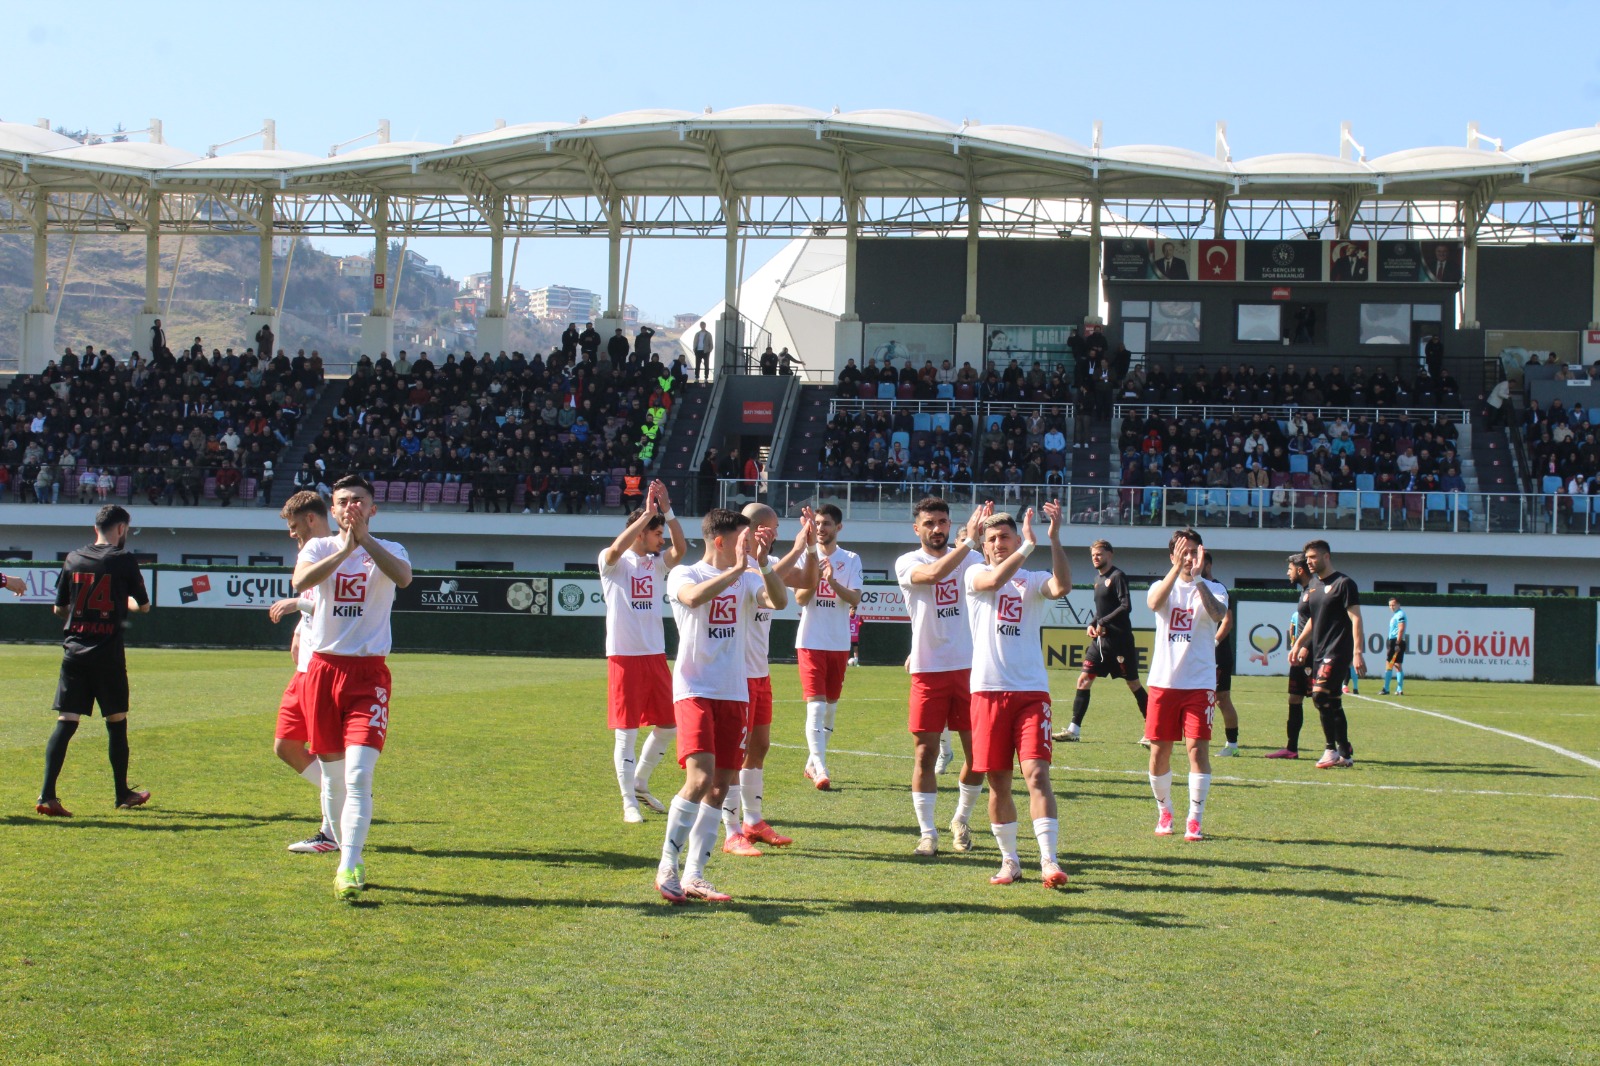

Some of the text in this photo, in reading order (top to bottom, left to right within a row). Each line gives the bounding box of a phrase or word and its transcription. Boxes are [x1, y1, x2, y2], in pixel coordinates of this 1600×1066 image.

[375, 275, 383, 285] B
[73, 572, 114, 617] 74
[421, 593, 479, 604] SAKARYA
[631, 601, 653, 610] Kilit
[816, 599, 836, 608] Kilit
[333, 605, 363, 617] Kilit
[937, 608, 960, 618] Kilit
[708, 627, 735, 639] Kilit
[850, 623, 856, 633] 3
[996, 624, 1021, 636] Kilit
[1168, 633, 1192, 643] Kilit
[1515, 659, 1531, 667] A.Ş.
[368, 704, 388, 729] 29
